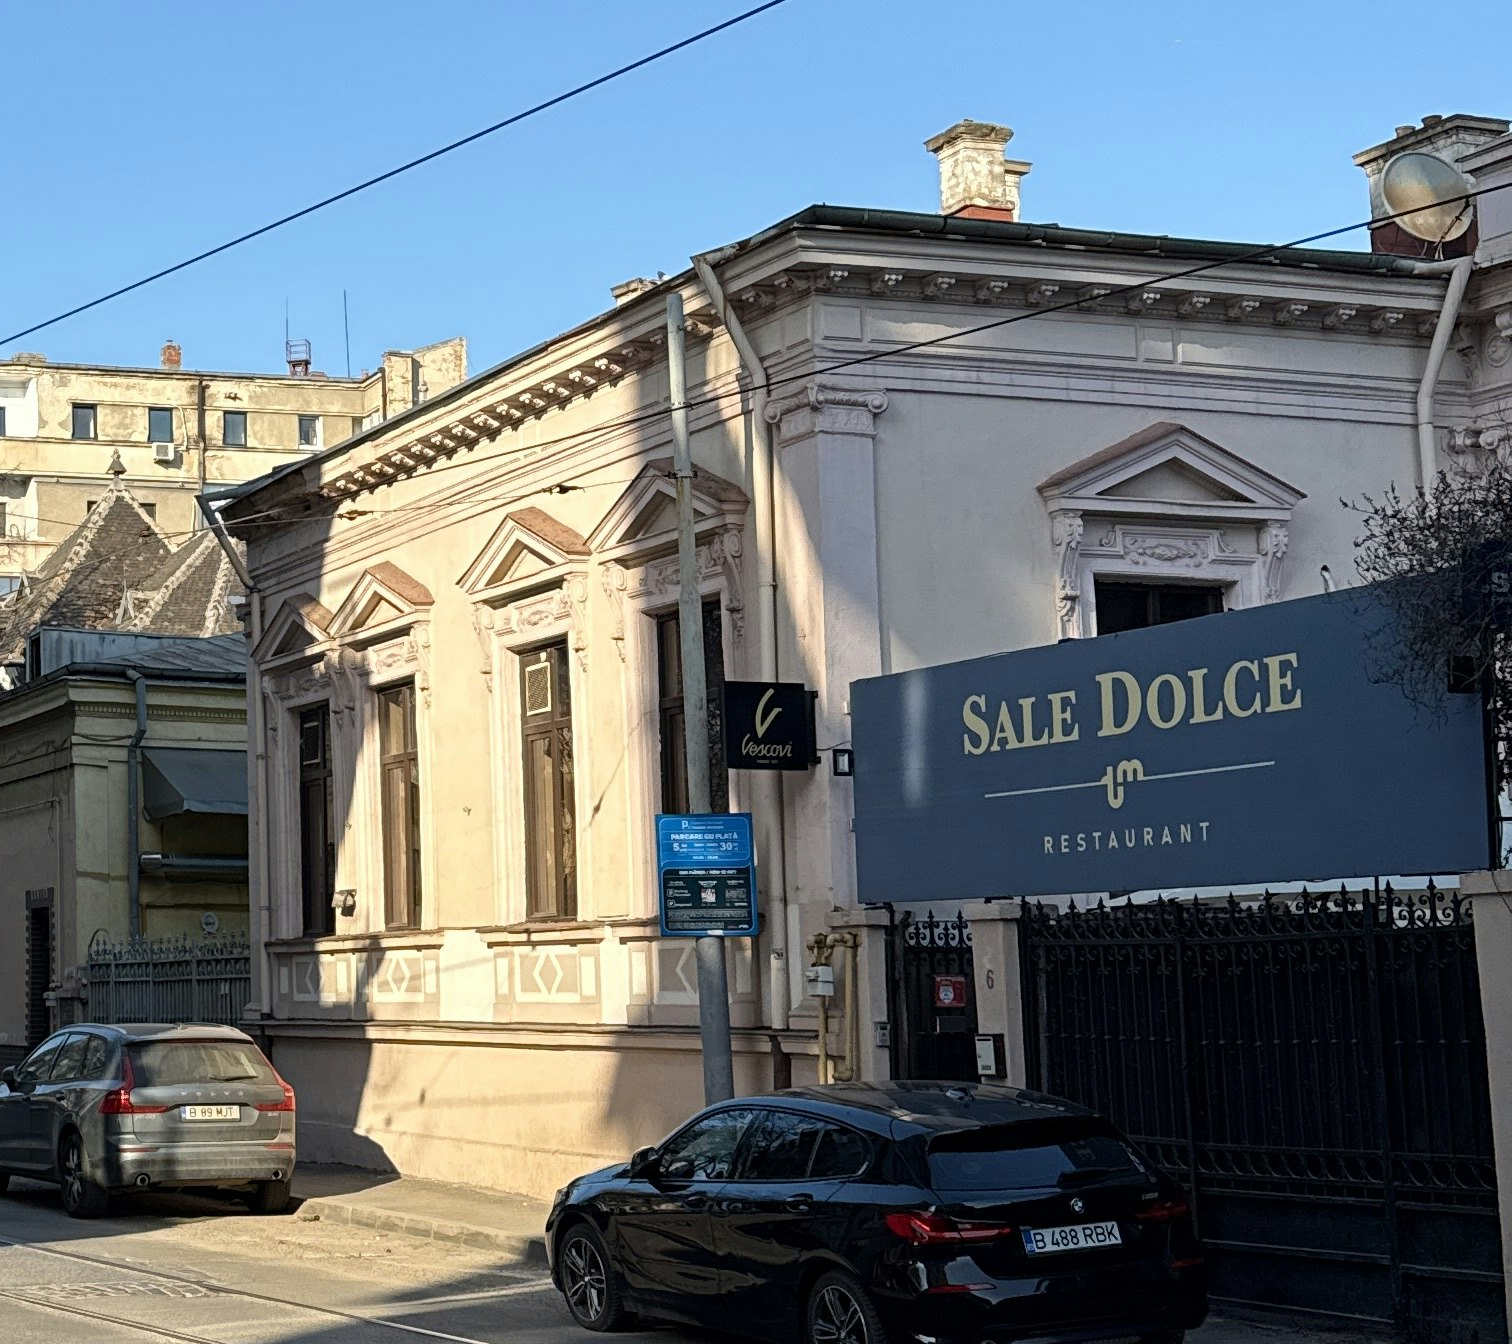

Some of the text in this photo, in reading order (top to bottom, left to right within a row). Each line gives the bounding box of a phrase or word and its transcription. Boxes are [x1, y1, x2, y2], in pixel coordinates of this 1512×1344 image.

[741, 733, 793, 758] Vescovi
[1043, 821, 1211, 854] RESTAURANT
[986, 969, 994, 990] 6
[216, 1107, 234, 1117] MJT
[1032, 1224, 1119, 1250] B 488 RBK
